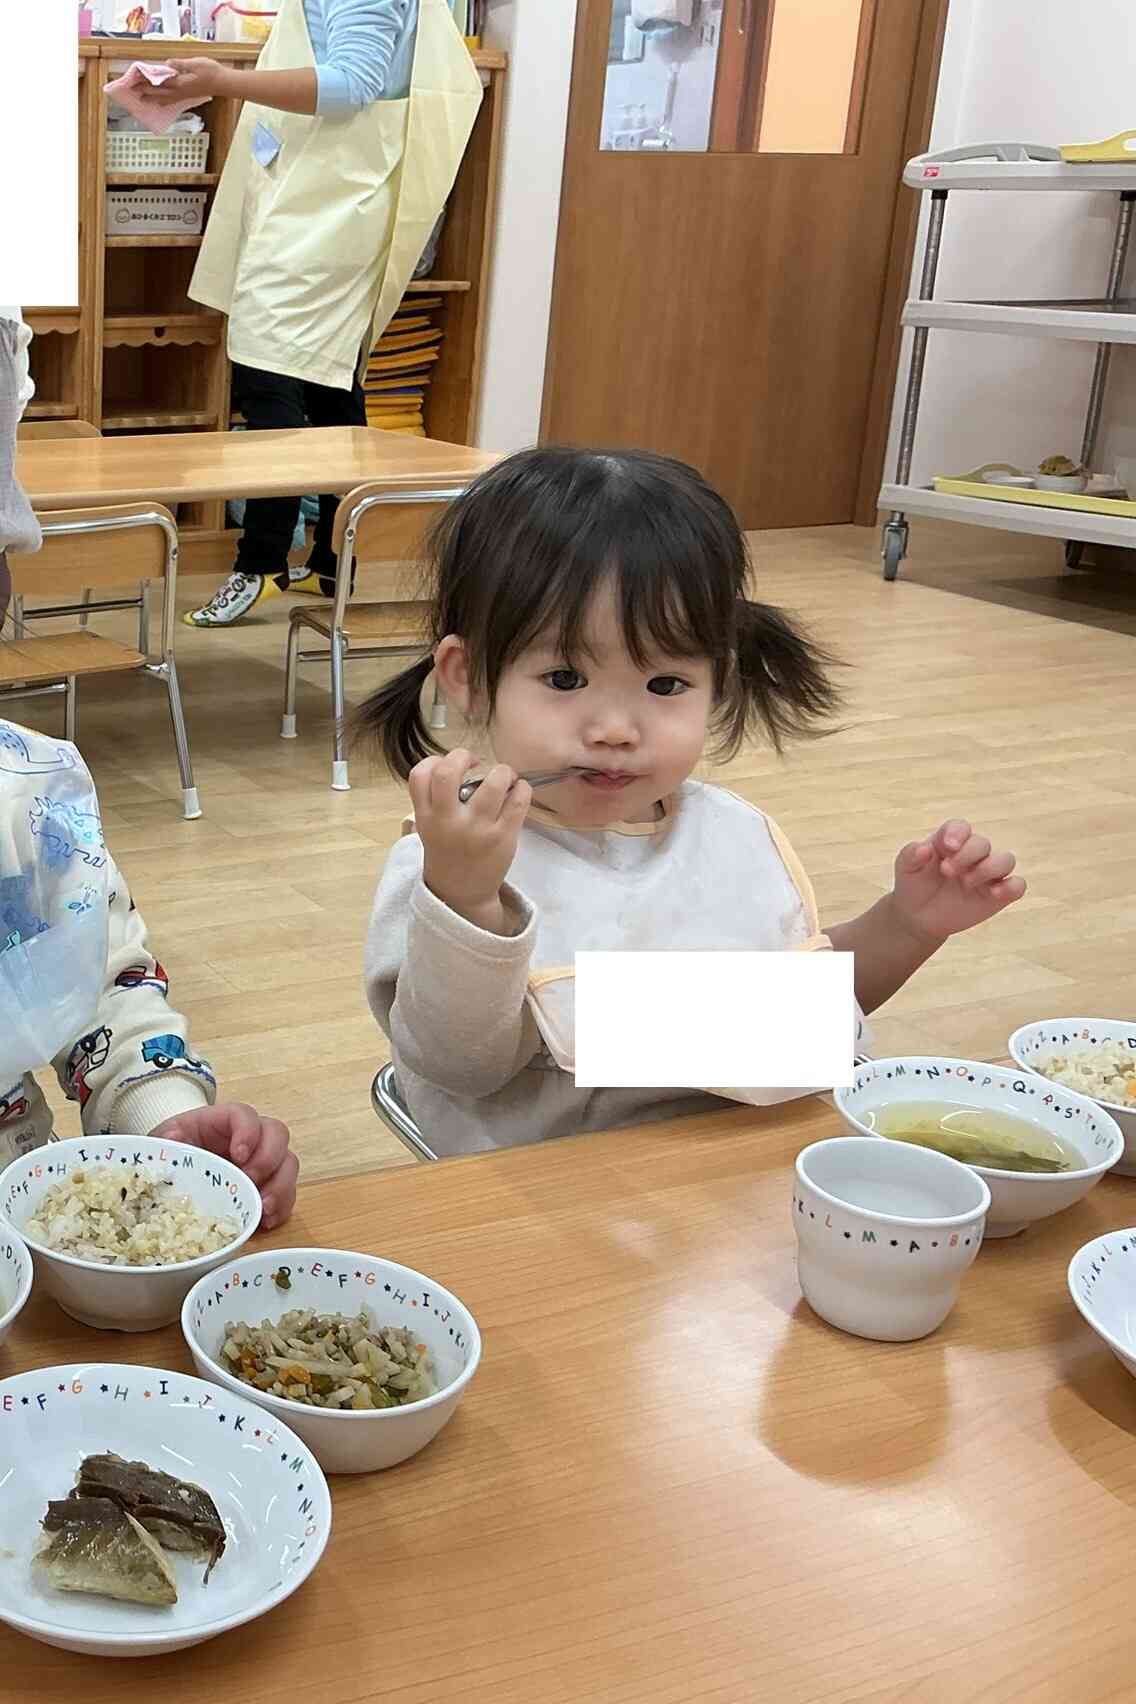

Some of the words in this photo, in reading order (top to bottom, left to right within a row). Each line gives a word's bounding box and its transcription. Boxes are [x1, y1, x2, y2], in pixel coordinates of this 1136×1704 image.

[1081, 1029, 1090, 1040] B
[895, 1064, 907, 1077] M
[926, 1066, 940, 1079] N
[956, 1066, 969, 1077] O
[981, 1077, 992, 1086] P
[1013, 1080, 1027, 1094] Q
[1042, 1094, 1054, 1105] R
[1064, 1107, 1073, 1119] S
[22, 1180, 29, 1195] F
[34, 1164, 42, 1178] G
[56, 1163, 66, 1176] H
[78, 1149, 88, 1162] I
[105, 1147, 115, 1161] J
[133, 1152, 143, 1165] K
[159, 1149, 167, 1161] L
[182, 1155, 194, 1169] M
[212, 1173, 221, 1187] N
[230, 1183, 238, 1196] O
[824, 1214, 833, 1229] L
[862, 1230, 878, 1244] M
[909, 1240, 921, 1254] A
[949, 1233, 960, 1247] B
[6, 1244, 13, 1259] D
[215, 1291, 224, 1305] A
[232, 1272, 241, 1286] B
[253, 1273, 263, 1287] C
[311, 1262, 324, 1277] E
[338, 1273, 349, 1289] F
[364, 1272, 377, 1286] G
[392, 1289, 407, 1304] H
[422, 1292, 431, 1308] I
[441, 1310, 452, 1322] J
[71, 1379, 83, 1394] G
[114, 1385, 129, 1401] H
[159, 1380, 169, 1395] I
[3, 1395, 14, 1411] E
[36, 1393, 48, 1410] F
[198, 1394, 213, 1409] J
[234, 1415, 246, 1432] K
[289, 1456, 304, 1473] M
[298, 1497, 313, 1514] N
[304, 1525, 318, 1537] O
